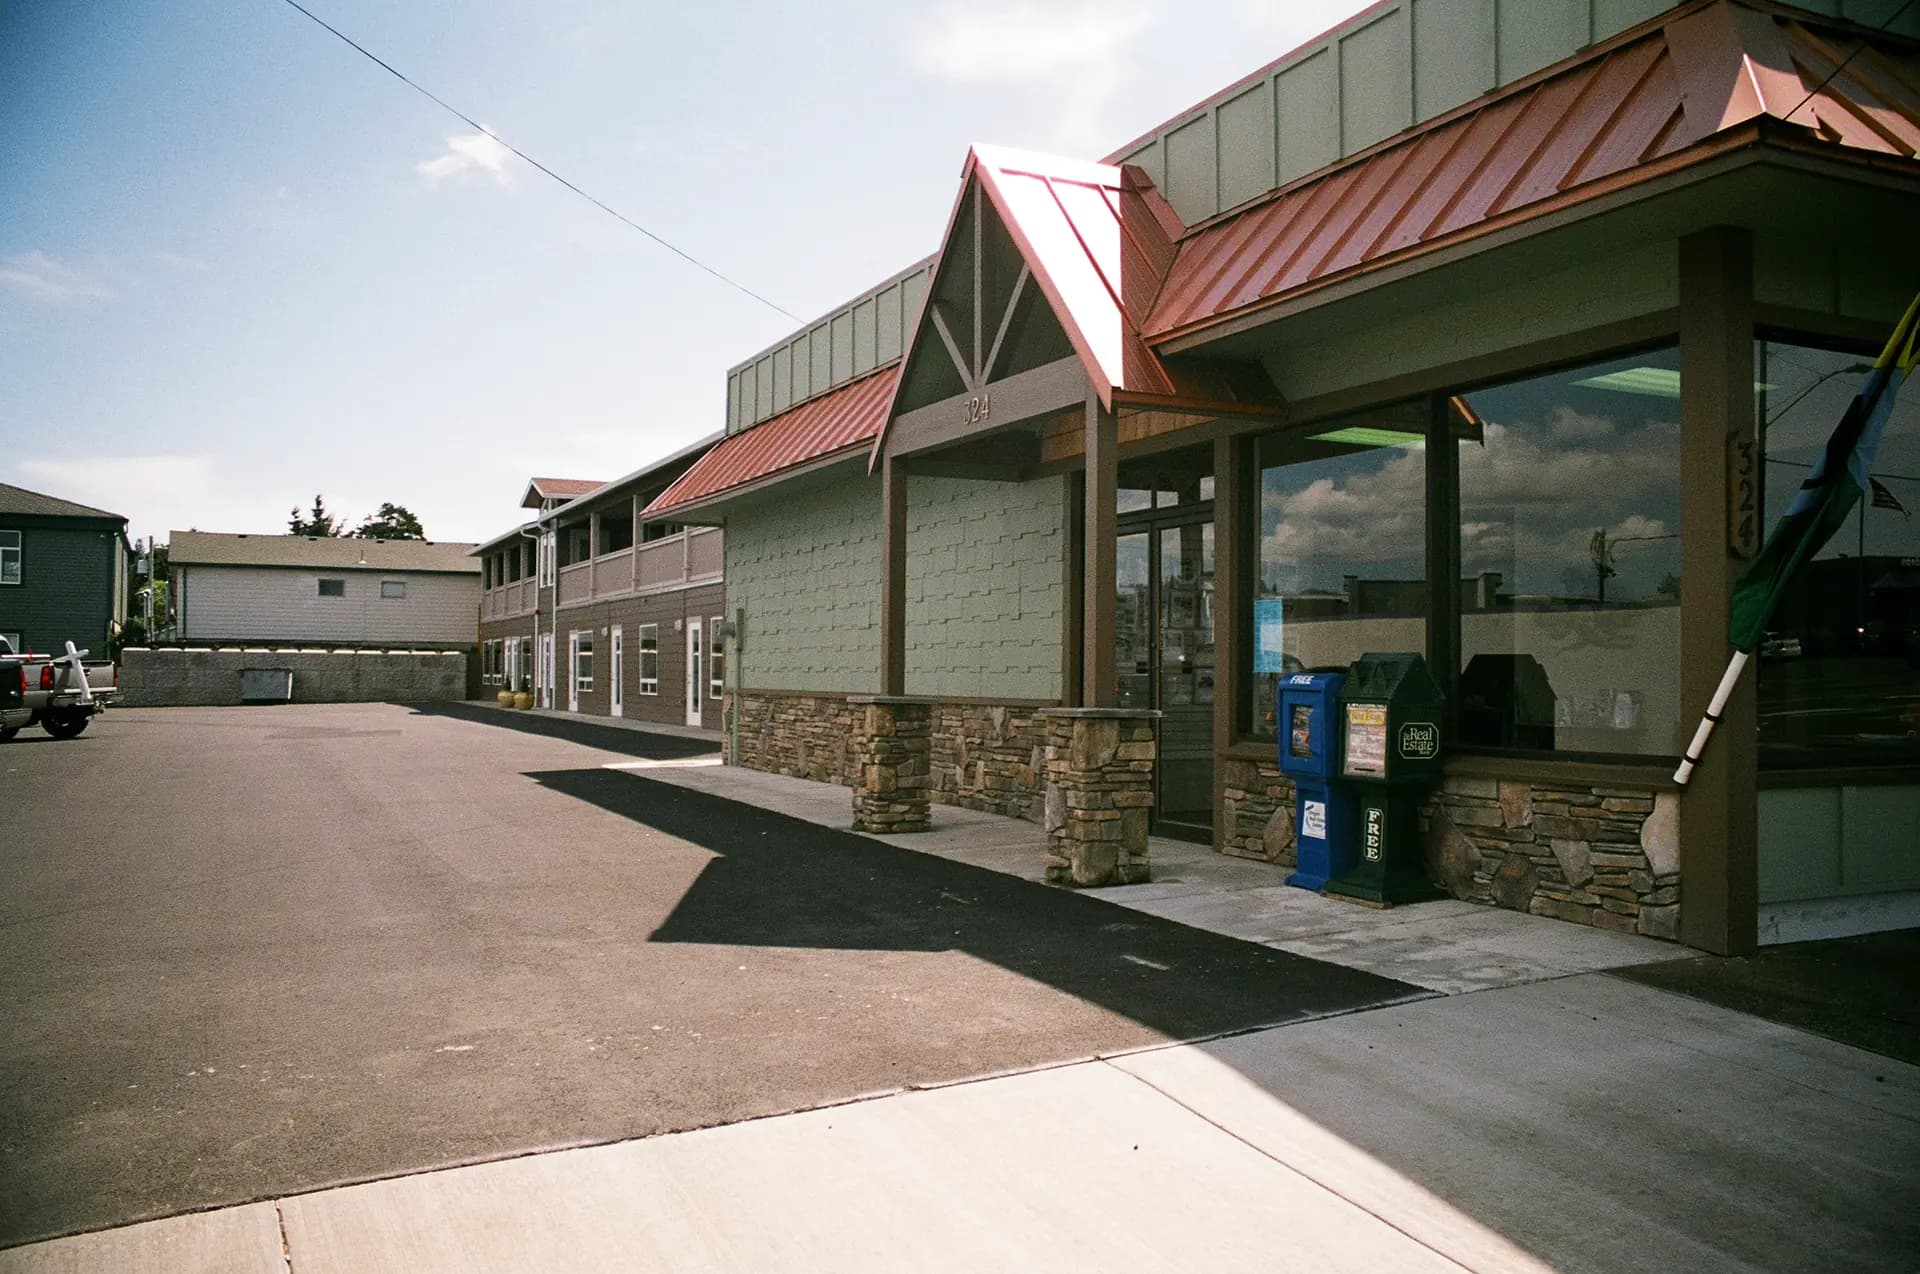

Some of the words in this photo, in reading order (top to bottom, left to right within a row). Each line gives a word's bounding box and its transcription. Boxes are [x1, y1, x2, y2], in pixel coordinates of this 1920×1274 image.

[964, 393, 990, 425] 324
[1738, 441, 1754, 547] 324
[1290, 674, 1314, 684] FREE
[1402, 737, 1434, 751] Estate
[1409, 727, 1432, 740] Real
[1367, 810, 1380, 860] FREE
